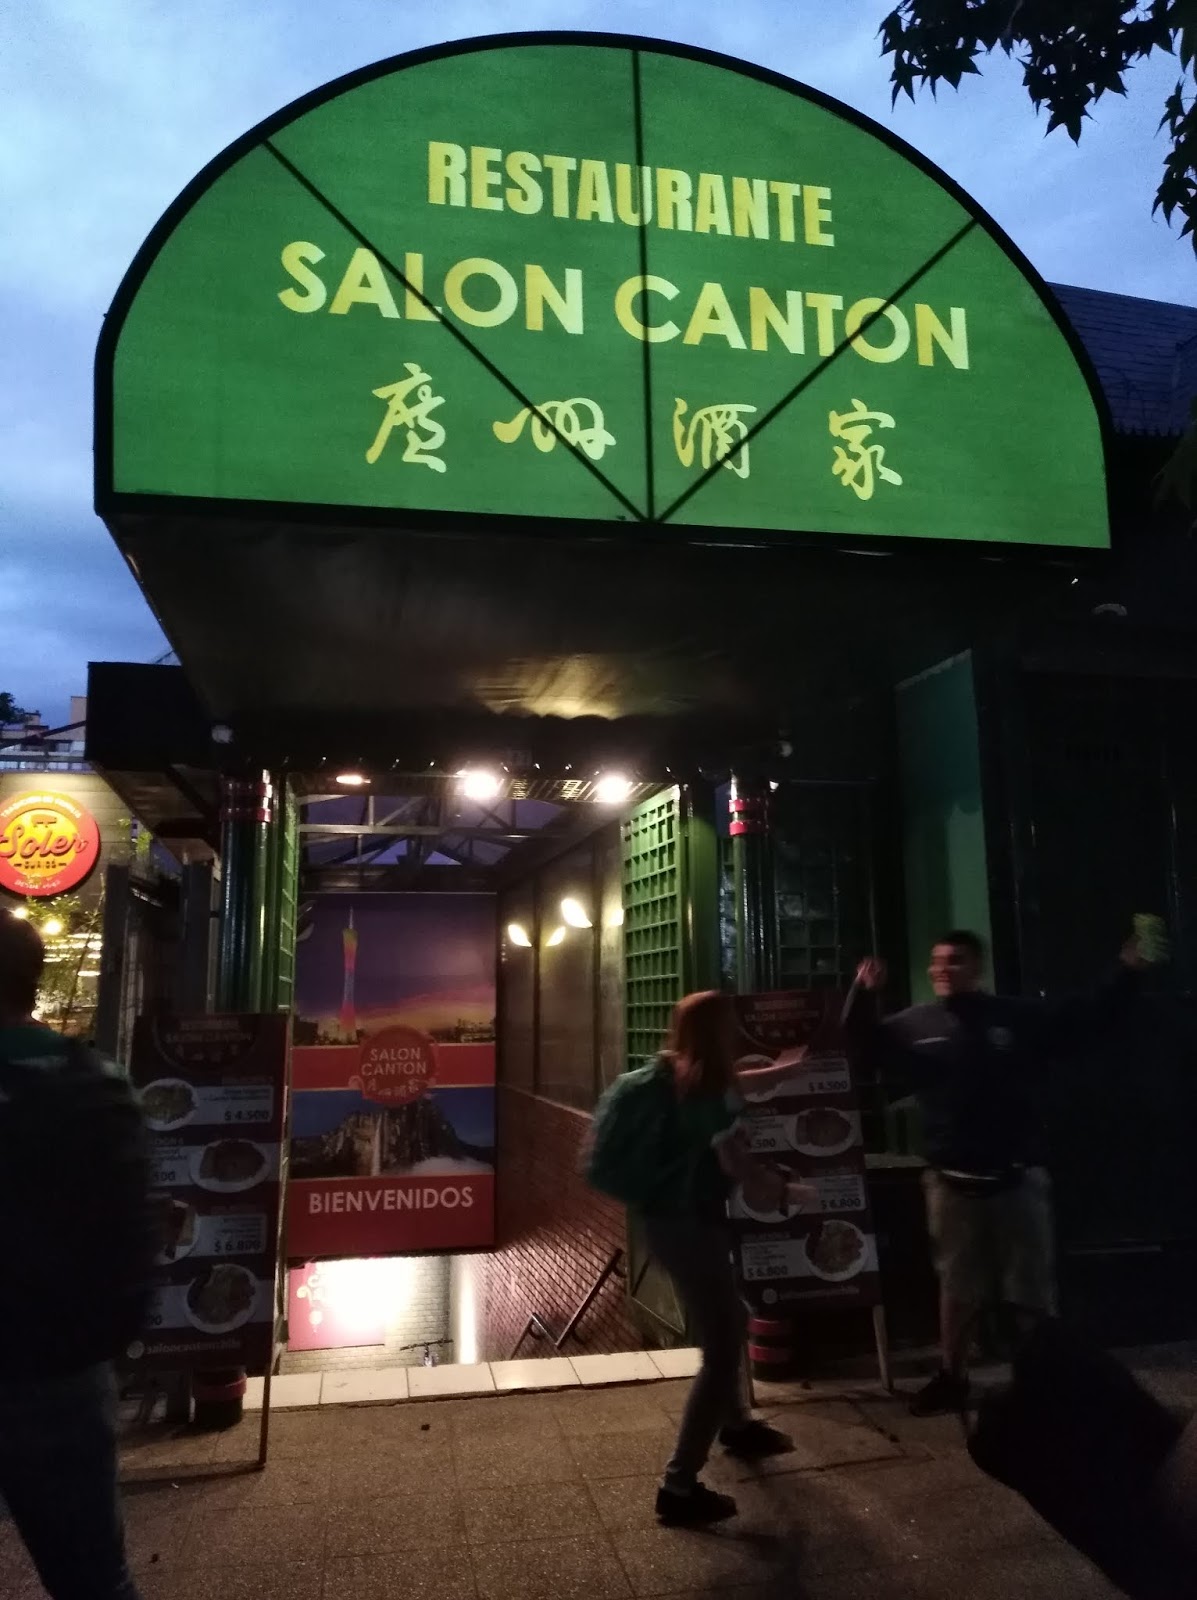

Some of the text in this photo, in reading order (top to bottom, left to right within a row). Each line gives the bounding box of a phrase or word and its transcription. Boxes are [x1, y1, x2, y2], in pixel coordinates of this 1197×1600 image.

[428, 141, 835, 248] RESTAURANTE
[278, 241, 969, 370] SALON CANTON
[361, 1061, 426, 1077] CANTON
[370, 1048, 421, 1062] SALON
[308, 1186, 474, 1214] BIENVENIDOS
